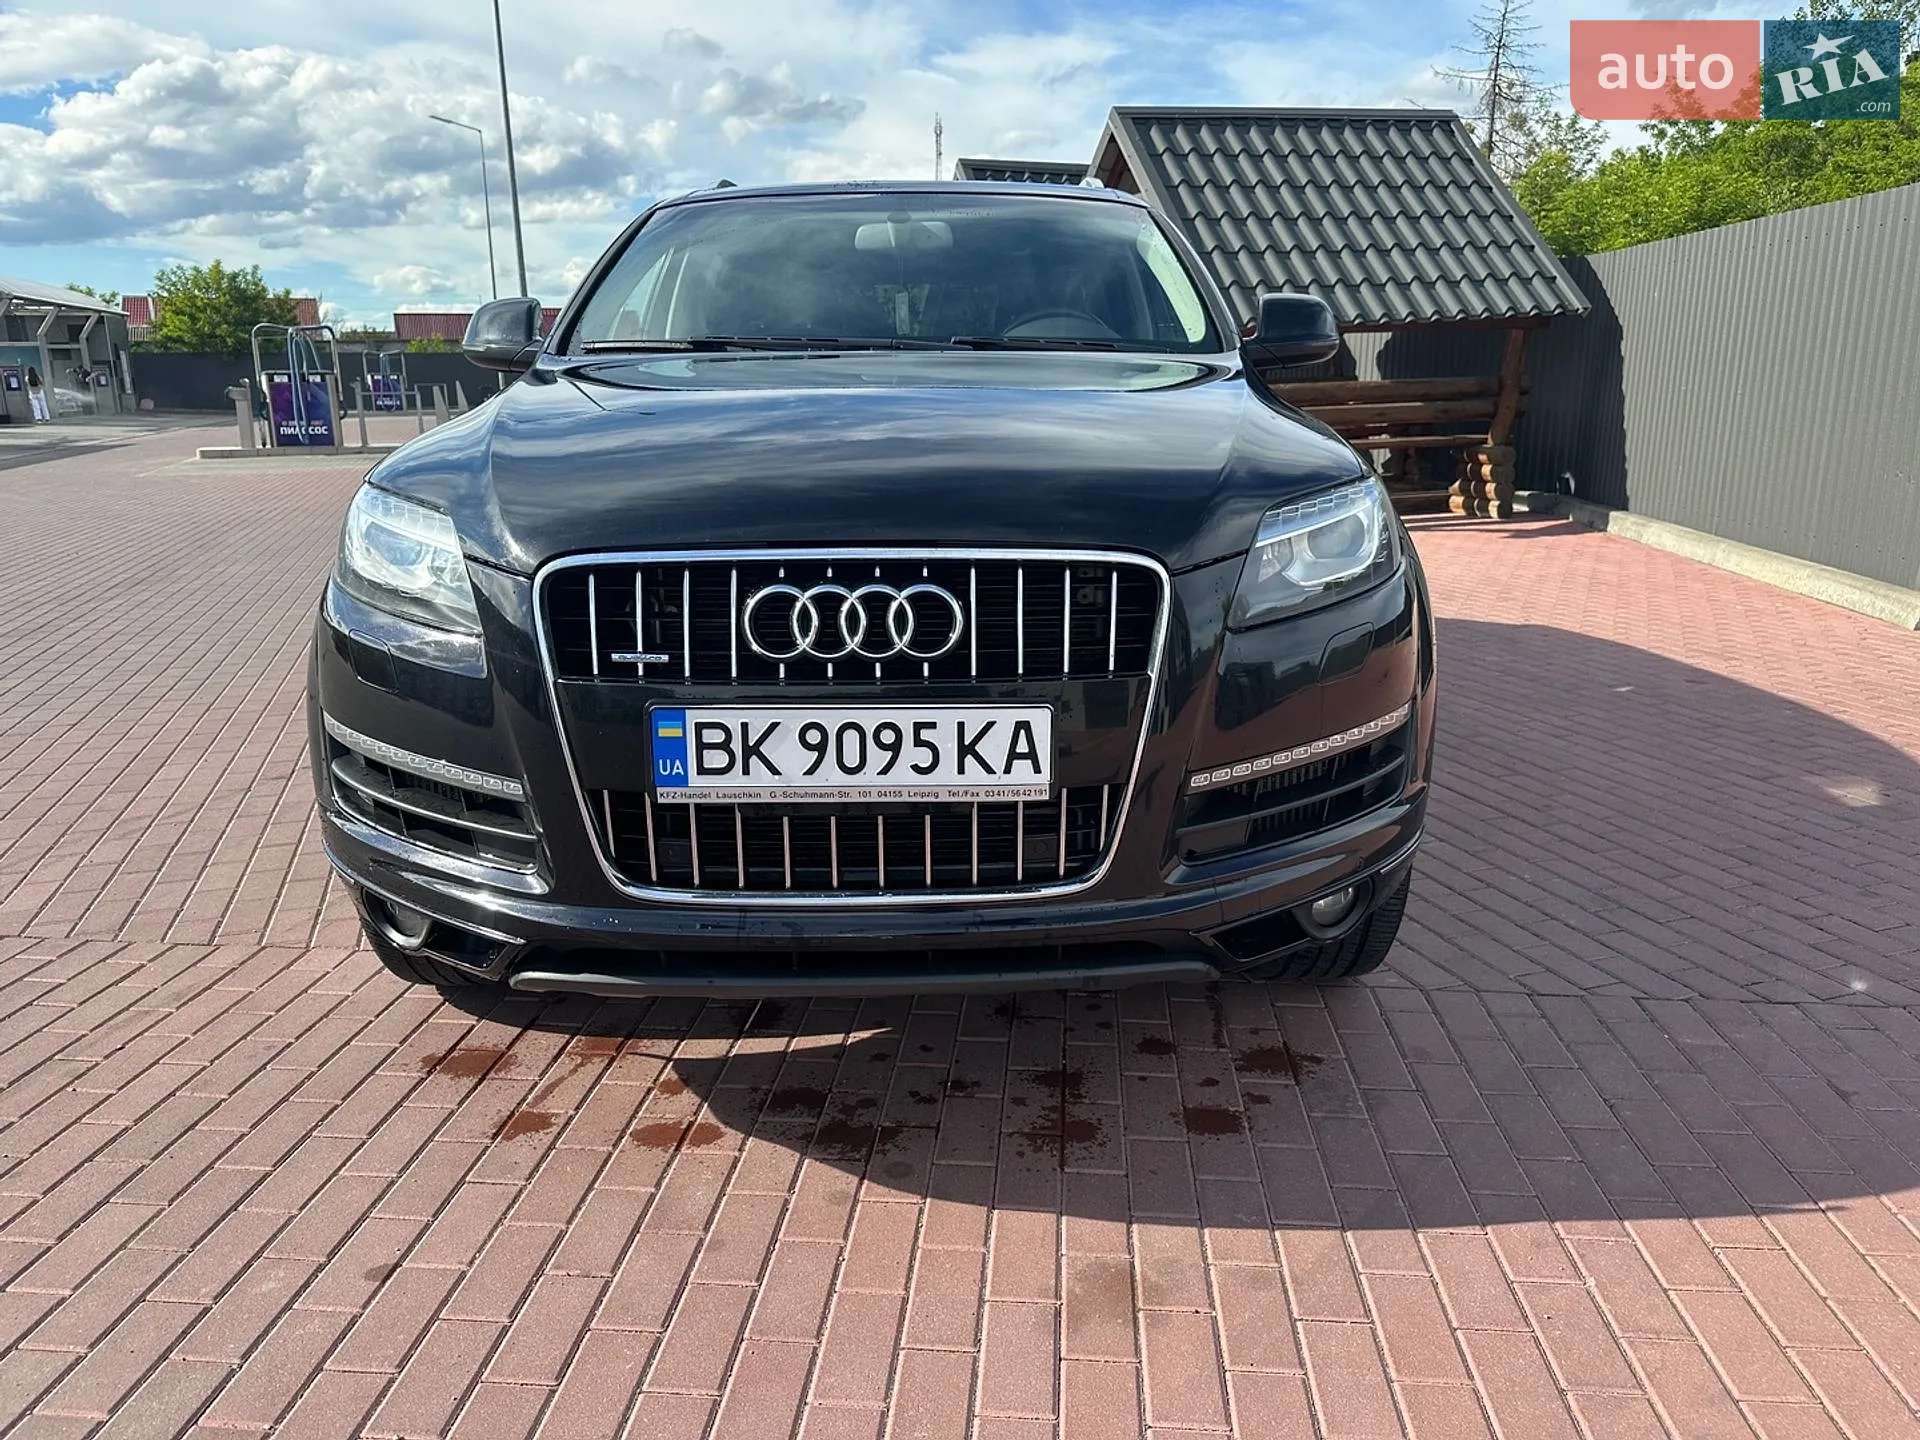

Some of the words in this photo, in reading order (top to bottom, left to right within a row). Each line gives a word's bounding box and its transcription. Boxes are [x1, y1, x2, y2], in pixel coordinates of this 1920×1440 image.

[694, 721, 783, 776] BK
[798, 721, 941, 776] 9095
[956, 720, 1043, 775] KA
[659, 759, 684, 776] UA
[660, 791, 712, 799] KFZ-Handel
[716, 790, 762, 799] Lauschkin
[858, 790, 872, 799] 101
[877, 790, 903, 799] 04155
[907, 790, 940, 799] Leipzig
[984, 788, 1048, 798] 0341/5642191
